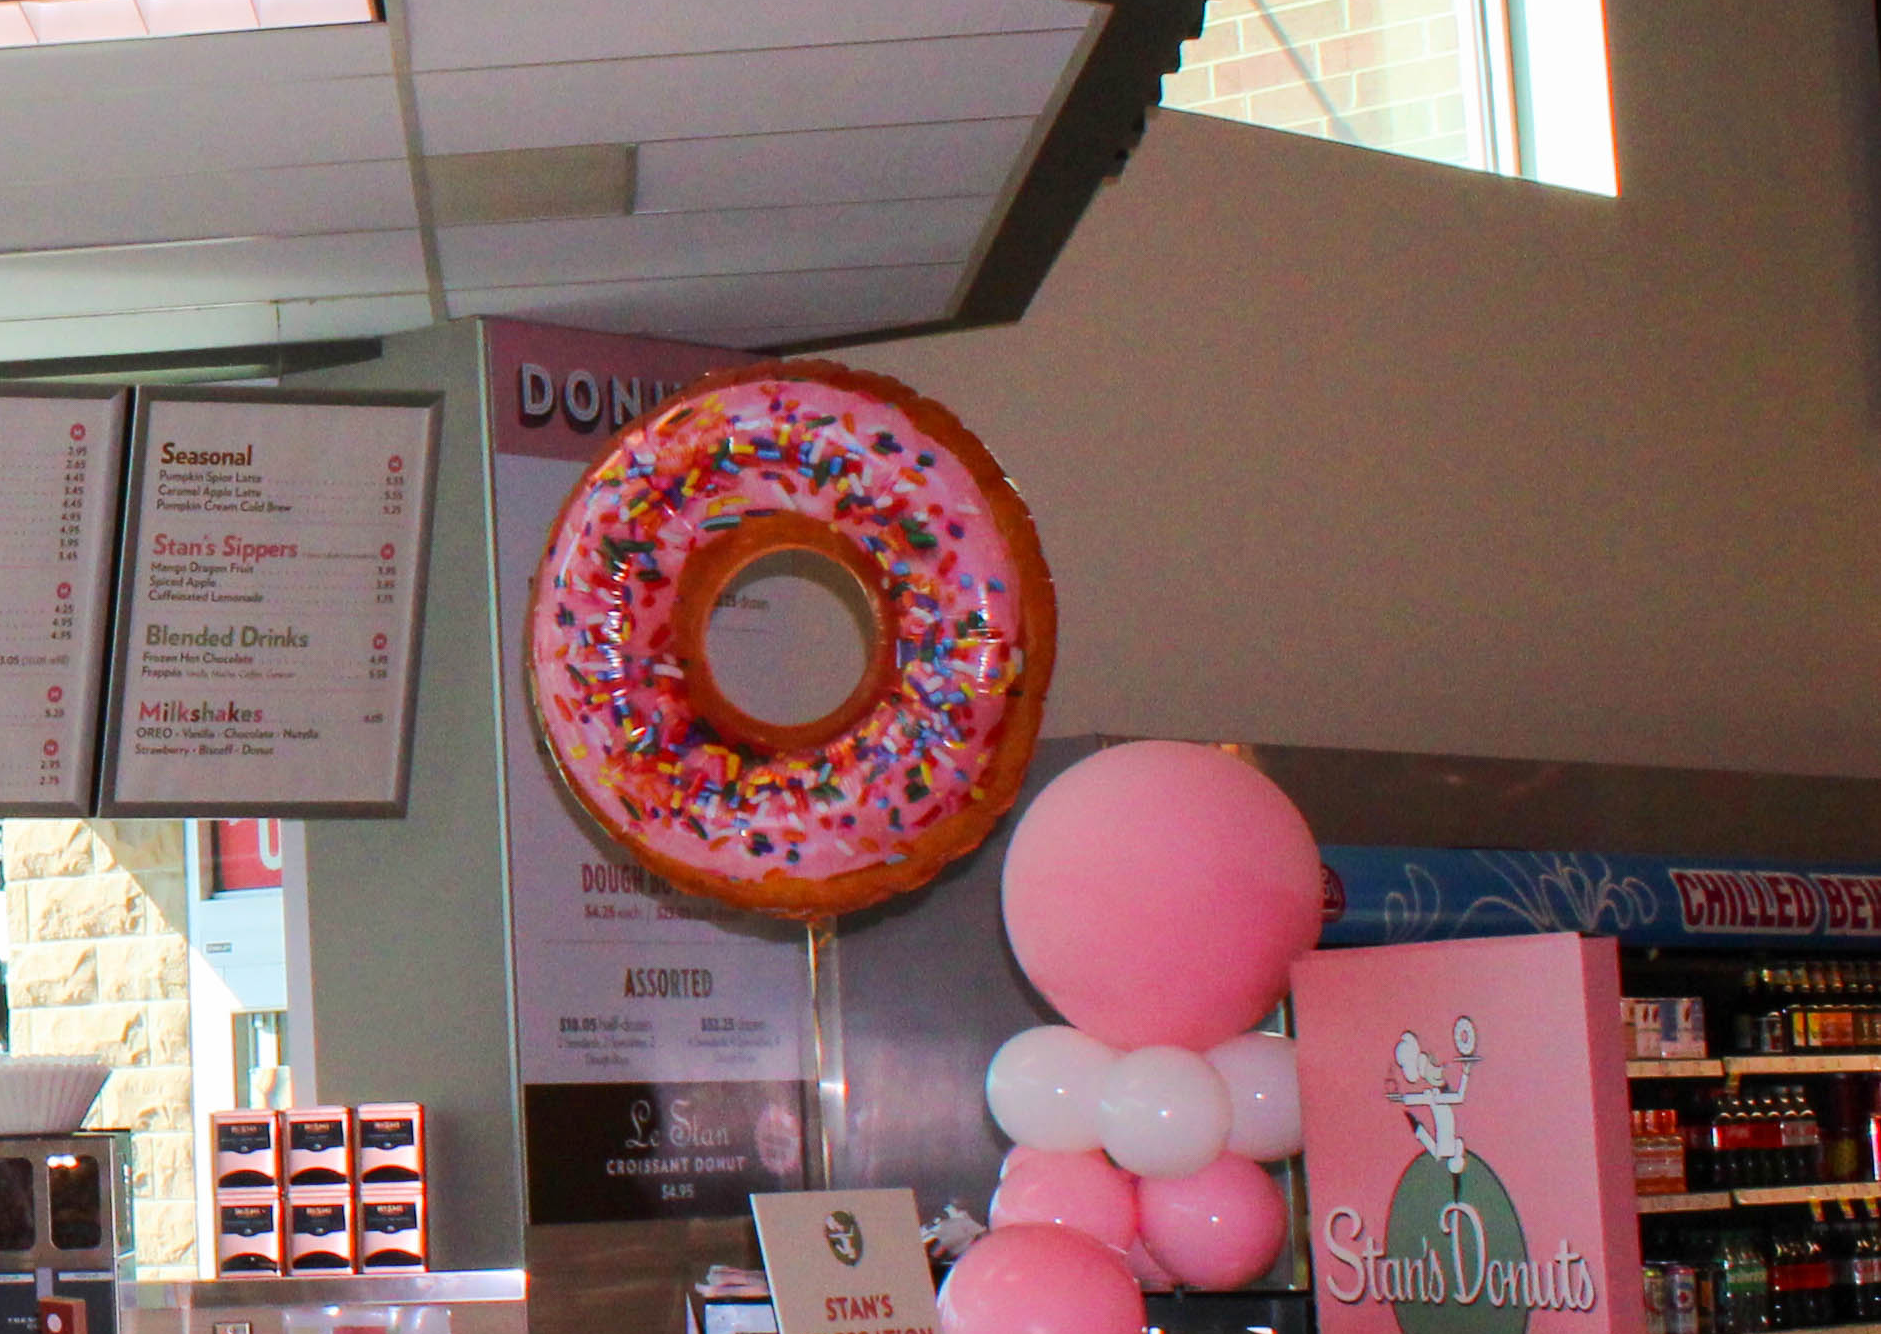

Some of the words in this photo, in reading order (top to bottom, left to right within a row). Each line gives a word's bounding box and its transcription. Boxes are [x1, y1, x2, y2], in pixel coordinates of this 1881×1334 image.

[161, 442, 253, 466] Seasonal
[159, 470, 204, 483] Pumpkin
[236, 473, 262, 483] Latte
[158, 485, 201, 496] Caramel
[203, 486, 232, 499] Apple
[235, 487, 262, 497] Latte
[157, 499, 201, 512] Pumpkin
[204, 501, 238, 511] Cream
[240, 501, 264, 512] Cold
[267, 502, 292, 512] Brew
[152, 532, 215, 557] Stan's
[222, 534, 298, 563] Sippers
[151, 562, 188, 574] Mango
[190, 563, 227, 575] Dragon
[230, 563, 254, 574] Fruit
[149, 576, 183, 588] Spiced
[185, 577, 216, 590] Apple
[148, 590, 209, 602] Caffeinated
[211, 593, 263, 603] Lemonade
[146, 624, 234, 648] Blended
[240, 626, 309, 648] Drinks
[142, 652, 178, 663] Frozen
[180, 653, 201, 662] Hot
[202, 653, 253, 664] Chocolate
[140, 700, 263, 723] Milkshakes
[136, 728, 173, 739] OREO
[183, 729, 215, 739] Vanilla
[224, 728, 274, 739] Chocolate
[283, 730, 318, 739] Nutella
[135, 744, 190, 757] Strawberry
[198, 744, 233, 755] Biscoff
[242, 745, 274, 755] Donut
[1670, 870, 1820, 932] CHILLED
[624, 968, 714, 998] ASSORTED
[606, 1159, 689, 1175] CROISSANT
[694, 1156, 747, 1173] DONUT
[661, 1184, 694, 1199] $4.95
[1324, 1203, 1446, 1307] Stan's
[1439, 1199, 1597, 1314] Donuts
[825, 1293, 895, 1323] STAN'S
